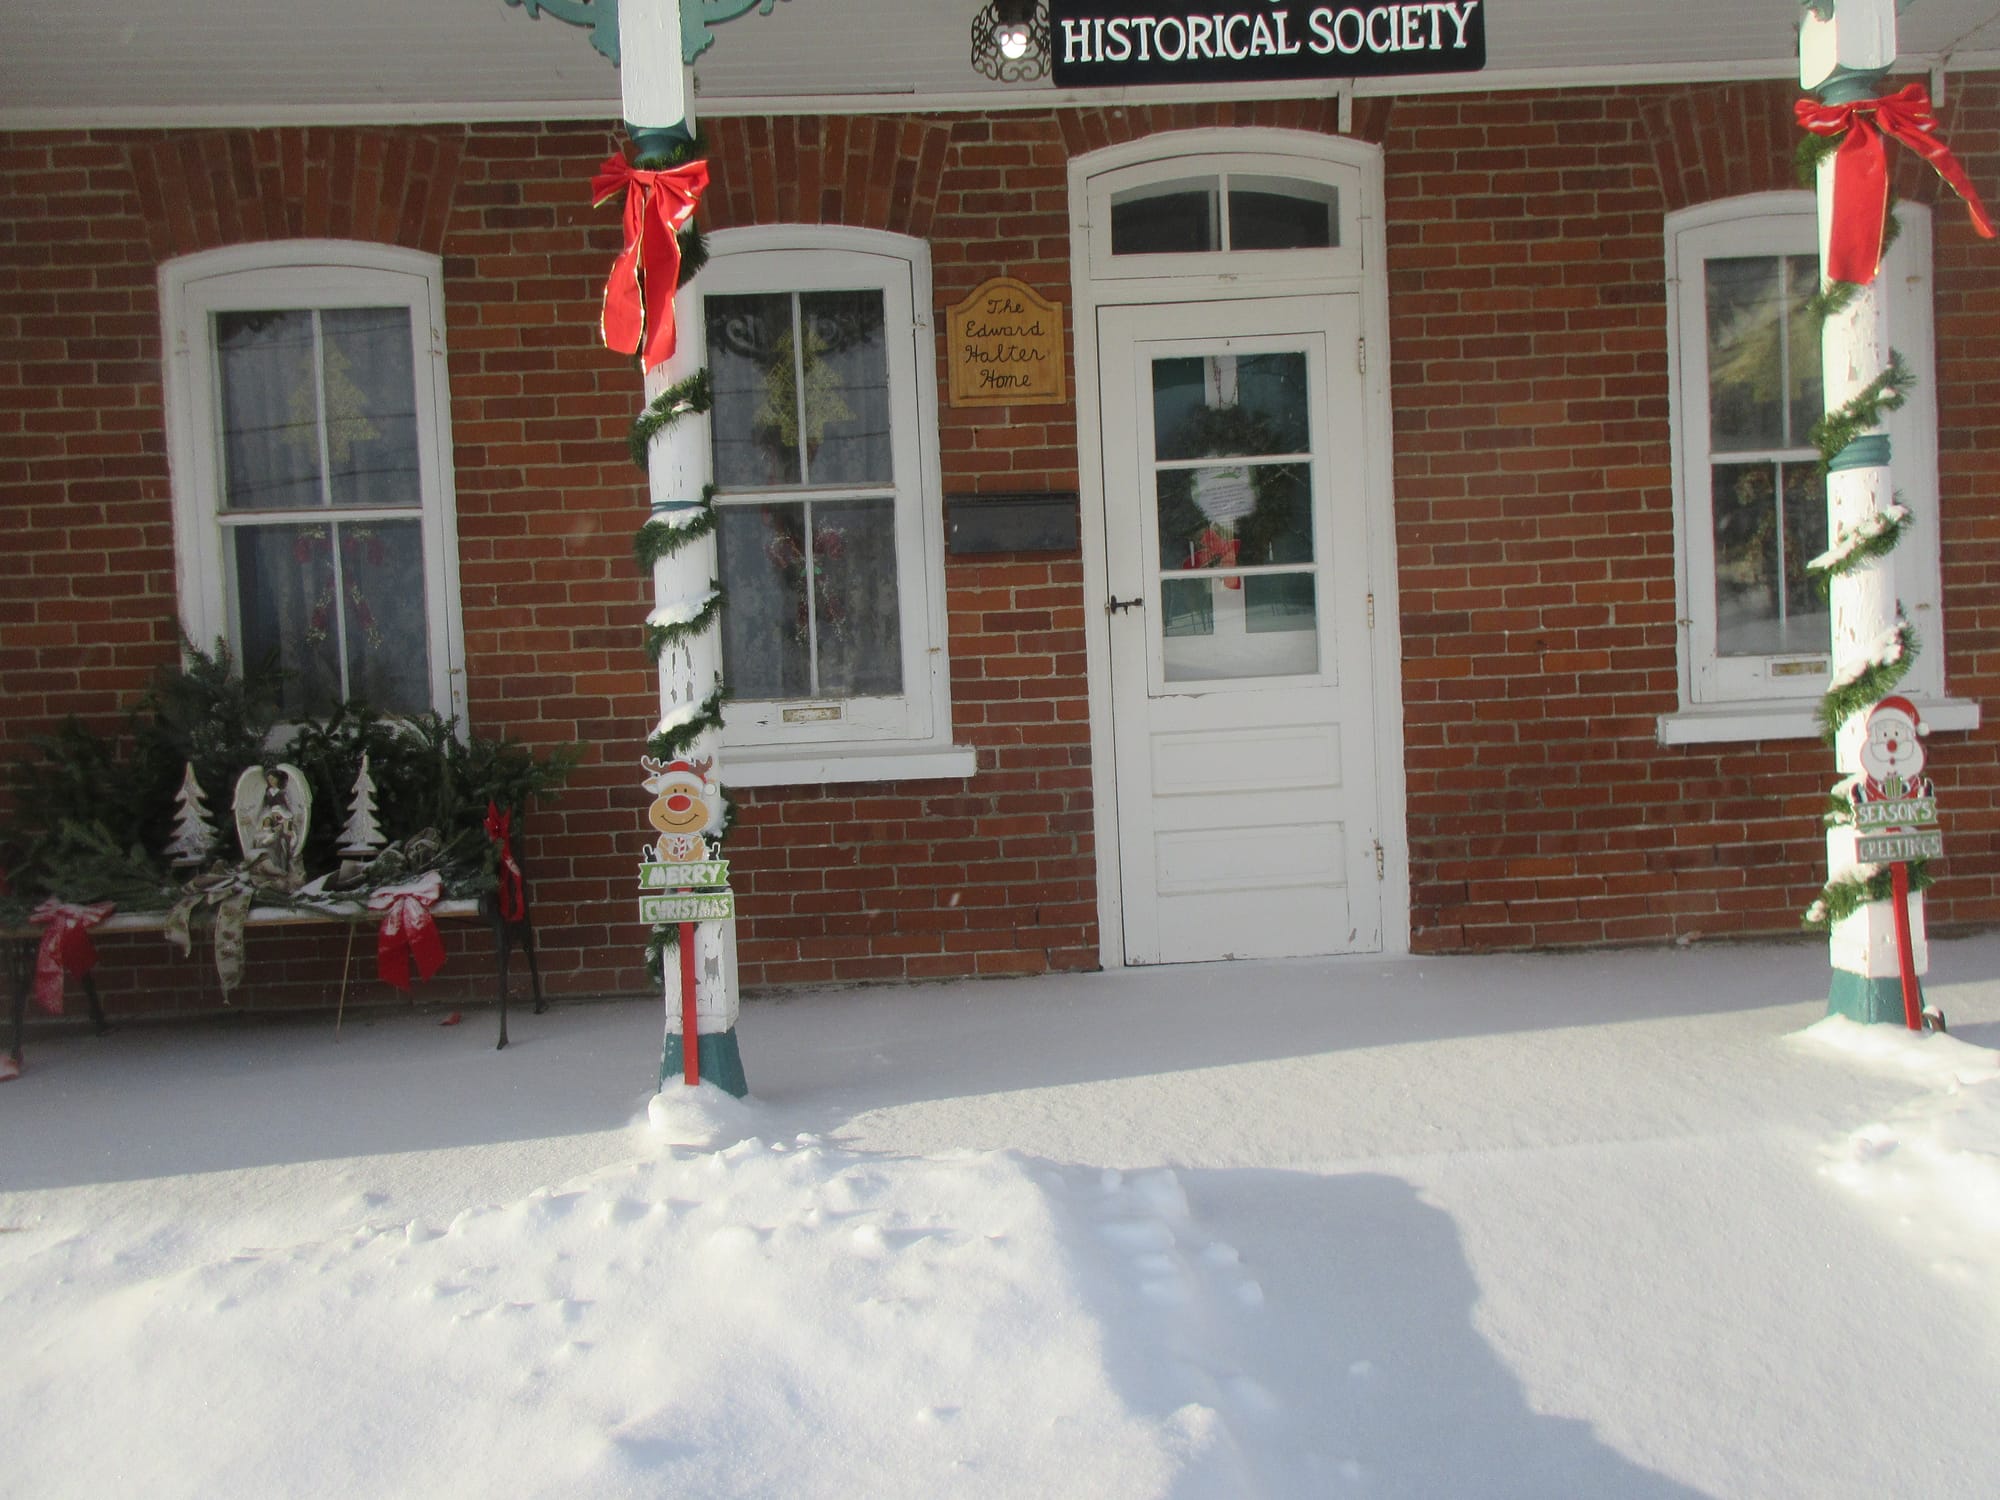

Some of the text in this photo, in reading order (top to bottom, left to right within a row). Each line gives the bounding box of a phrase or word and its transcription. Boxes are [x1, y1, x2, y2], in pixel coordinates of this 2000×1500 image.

[1062, 2, 1477, 63] HISTORICAL SOCIETY
[987, 298, 1025, 314] The
[965, 321, 1045, 338] Edward
[965, 343, 1046, 364] Halter
[979, 368, 1032, 389] Home
[1859, 801, 1932, 823] SEASON'S
[1861, 835, 1940, 861] GREETINGS
[649, 864, 720, 885] MERRY
[645, 898, 729, 921] CHRISTMAS
